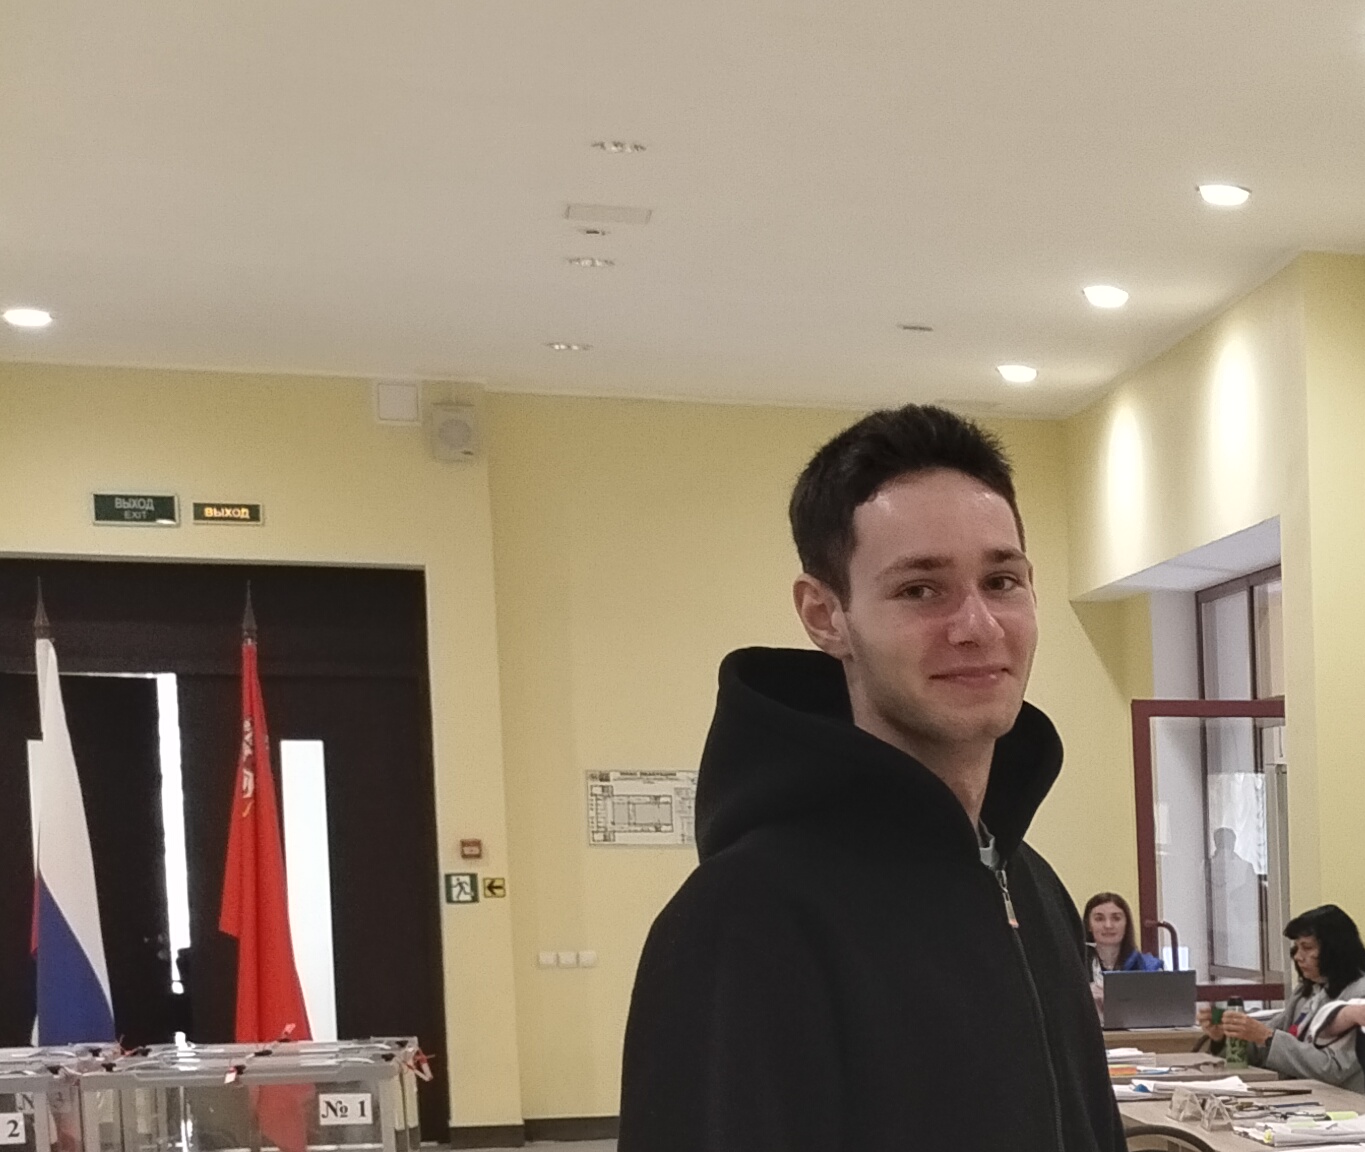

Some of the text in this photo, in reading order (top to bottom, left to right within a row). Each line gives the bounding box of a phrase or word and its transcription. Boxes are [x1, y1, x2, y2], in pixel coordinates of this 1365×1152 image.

[114, 497, 155, 511] ВЫХОД
[124, 511, 148, 520] EXIT
[204, 506, 250, 519] ВЫХОД
[321, 1100, 366, 1119] № 1
[7, 1119, 21, 1138] 2
